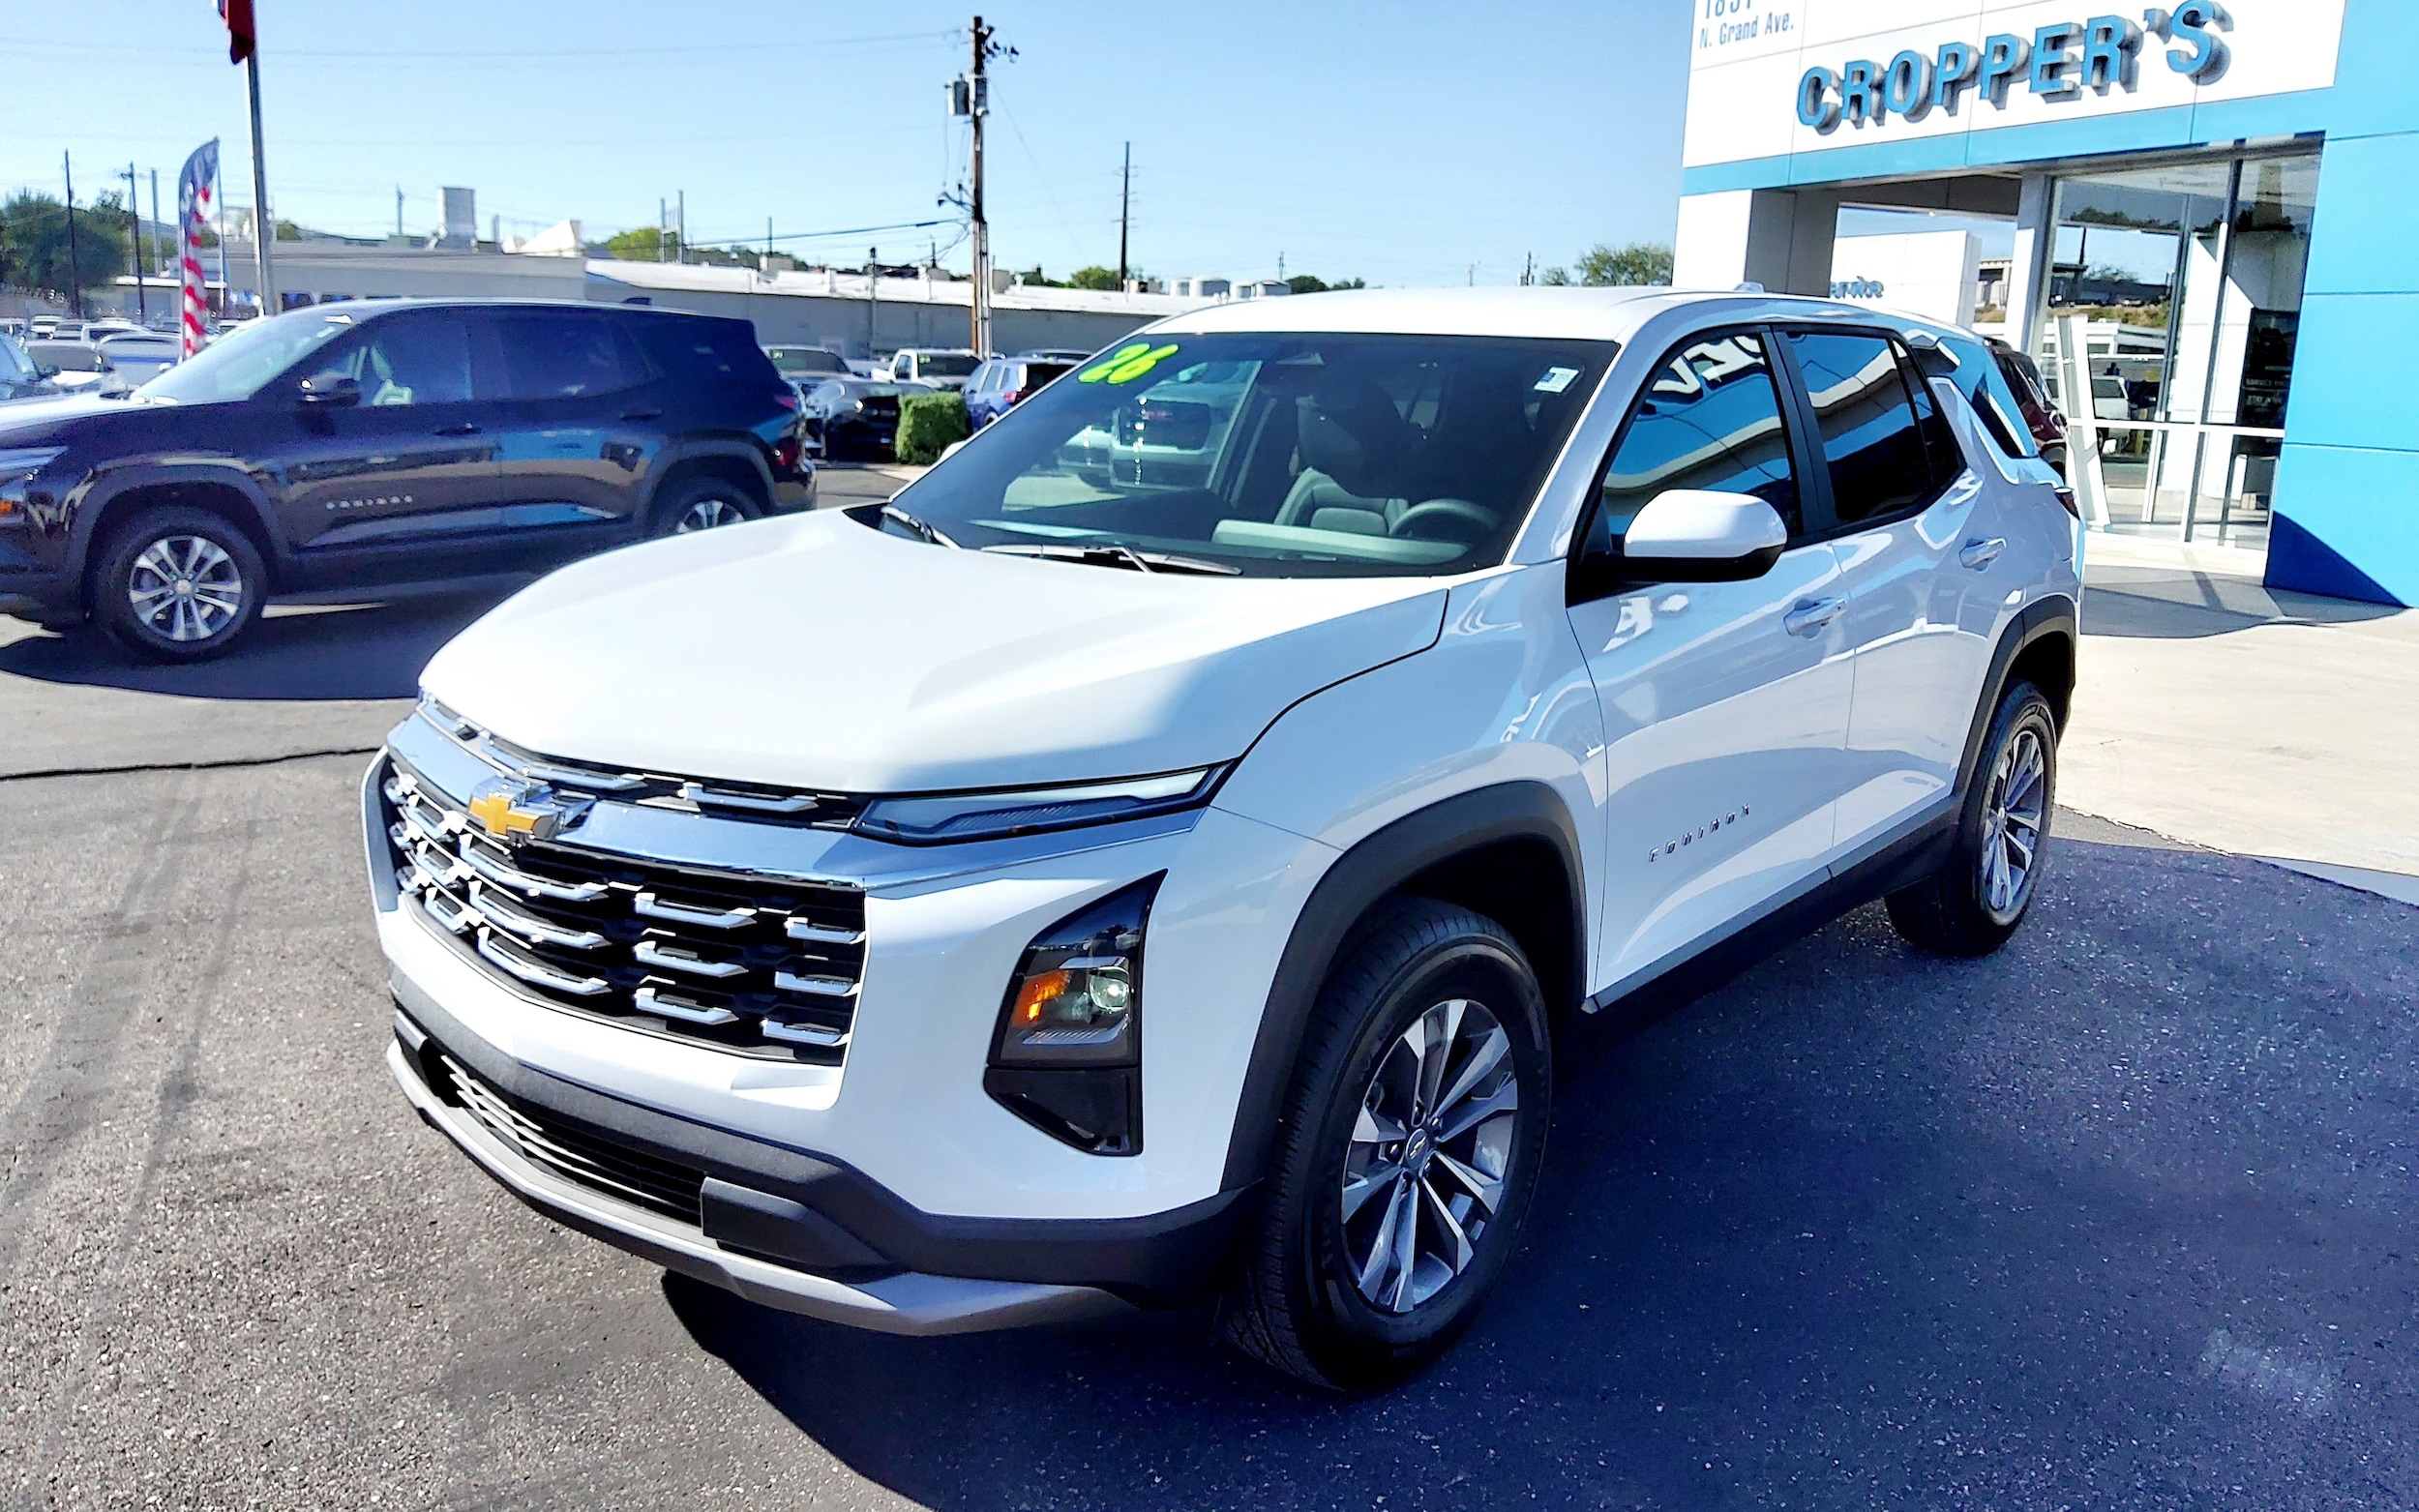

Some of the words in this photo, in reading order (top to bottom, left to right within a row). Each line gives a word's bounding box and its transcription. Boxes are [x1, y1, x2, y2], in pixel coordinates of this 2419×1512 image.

[1699, 27, 1713, 48] N.
[1718, 15, 1759, 44] Grand
[1764, 11, 1794, 35] Ave.
[1797, 0, 2231, 133] CROPPER'S
[1830, 275, 1885, 299] ervice
[1077, 342, 1180, 384] 26
